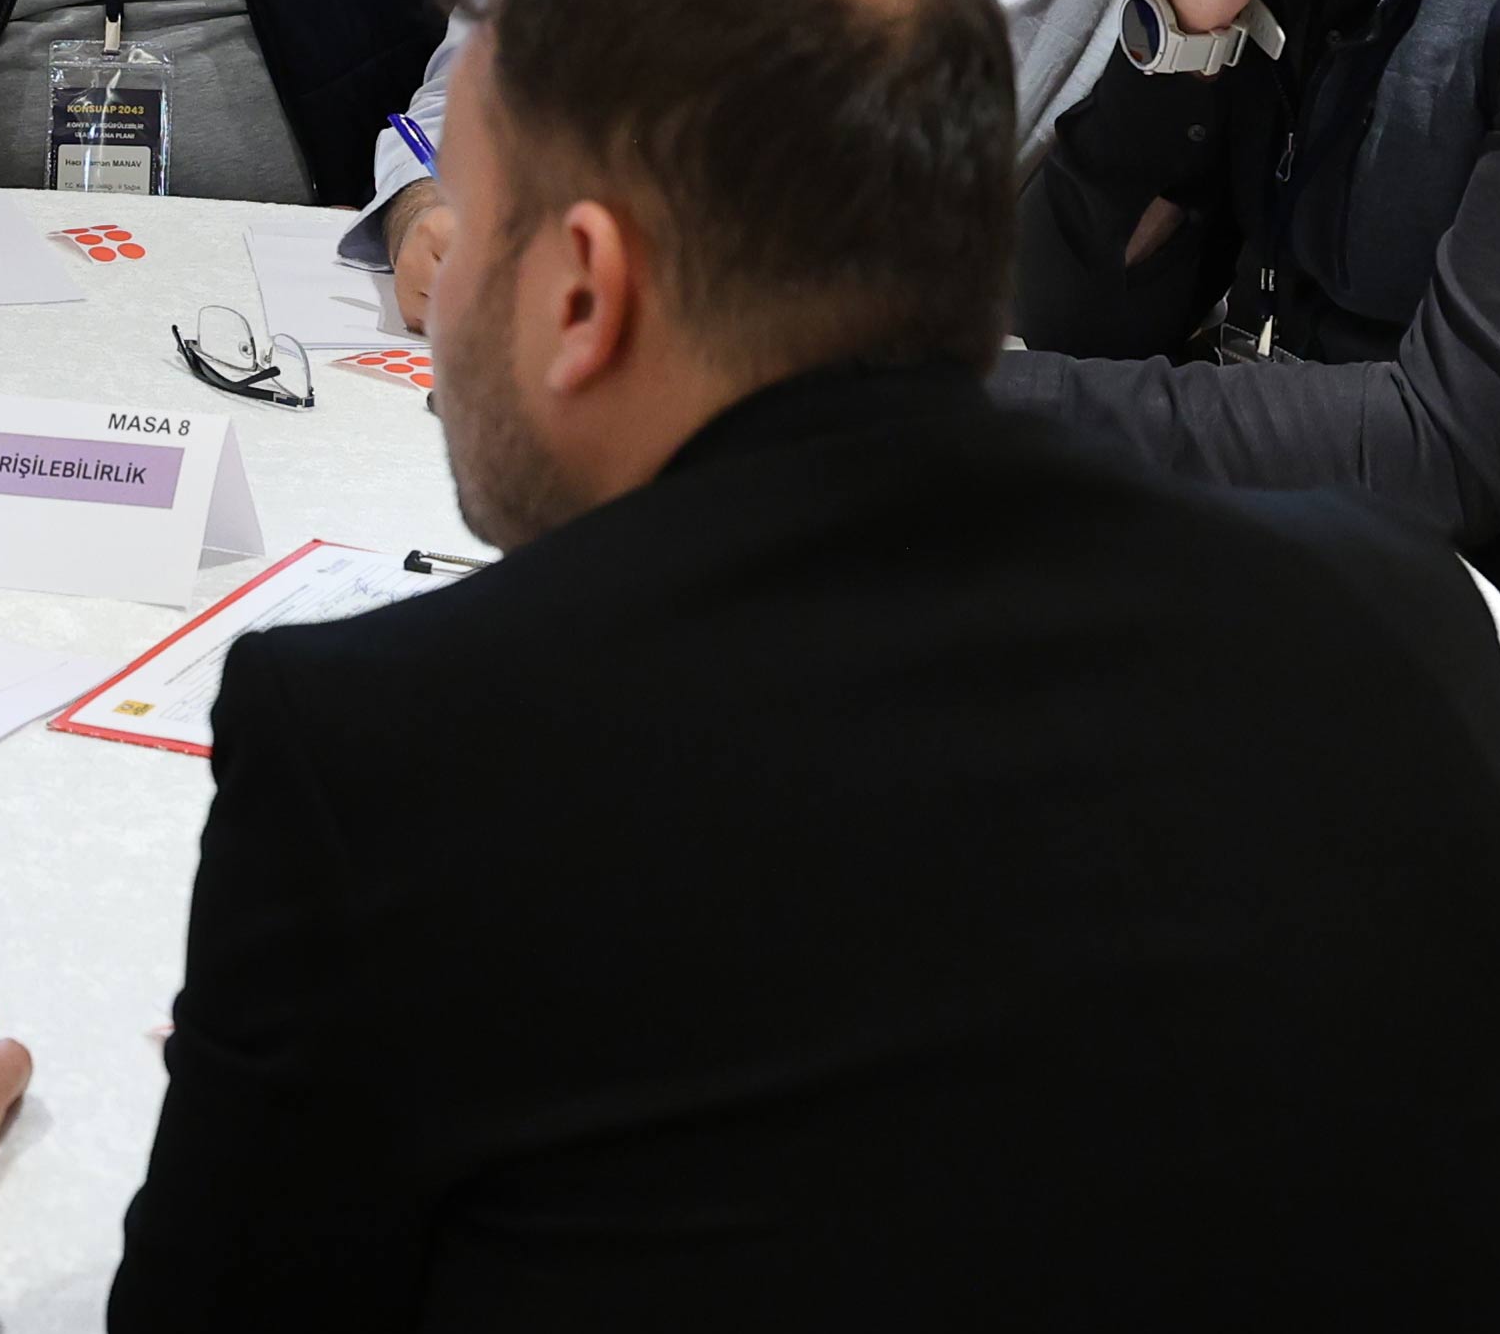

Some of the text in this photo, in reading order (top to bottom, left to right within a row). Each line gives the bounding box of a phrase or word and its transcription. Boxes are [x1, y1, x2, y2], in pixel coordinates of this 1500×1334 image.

[119, 105, 144, 114] 2043
[107, 412, 191, 436] MASA 8
